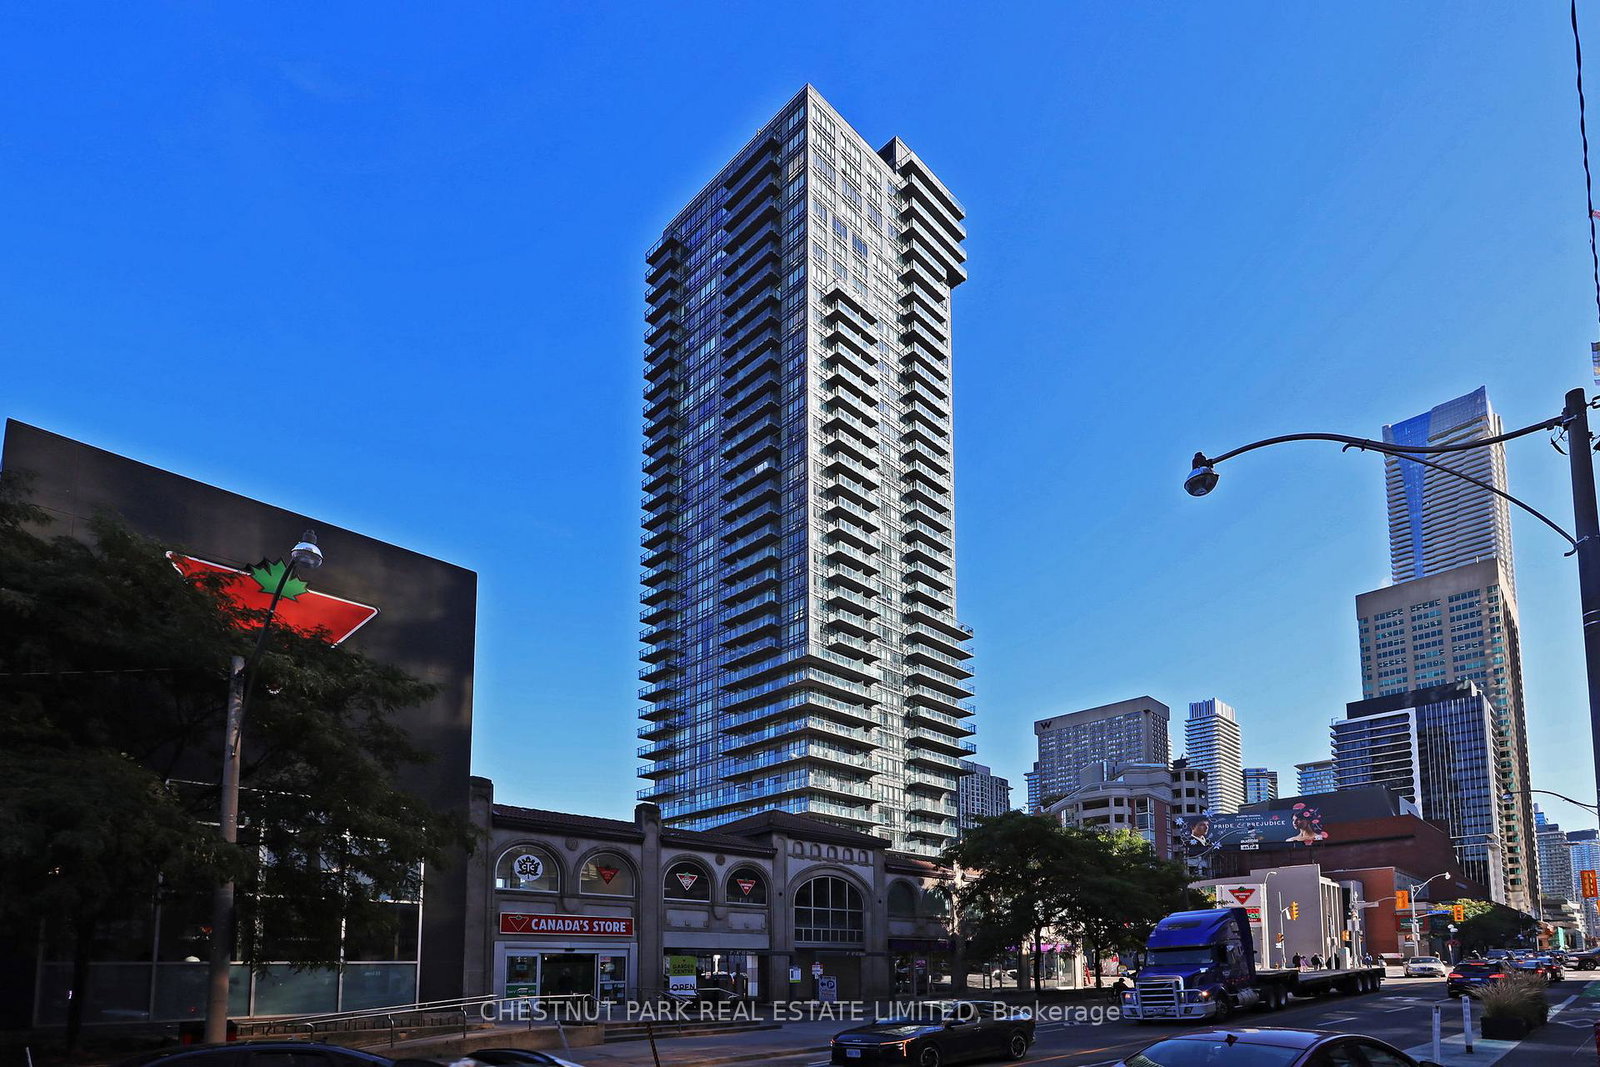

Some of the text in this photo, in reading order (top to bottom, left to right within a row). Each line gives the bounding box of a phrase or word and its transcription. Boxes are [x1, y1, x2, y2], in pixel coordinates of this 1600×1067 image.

[1040, 721, 1052, 730] W
[531, 918, 627, 933] CANADA'S STORE
[671, 983, 696, 991] OPEN
